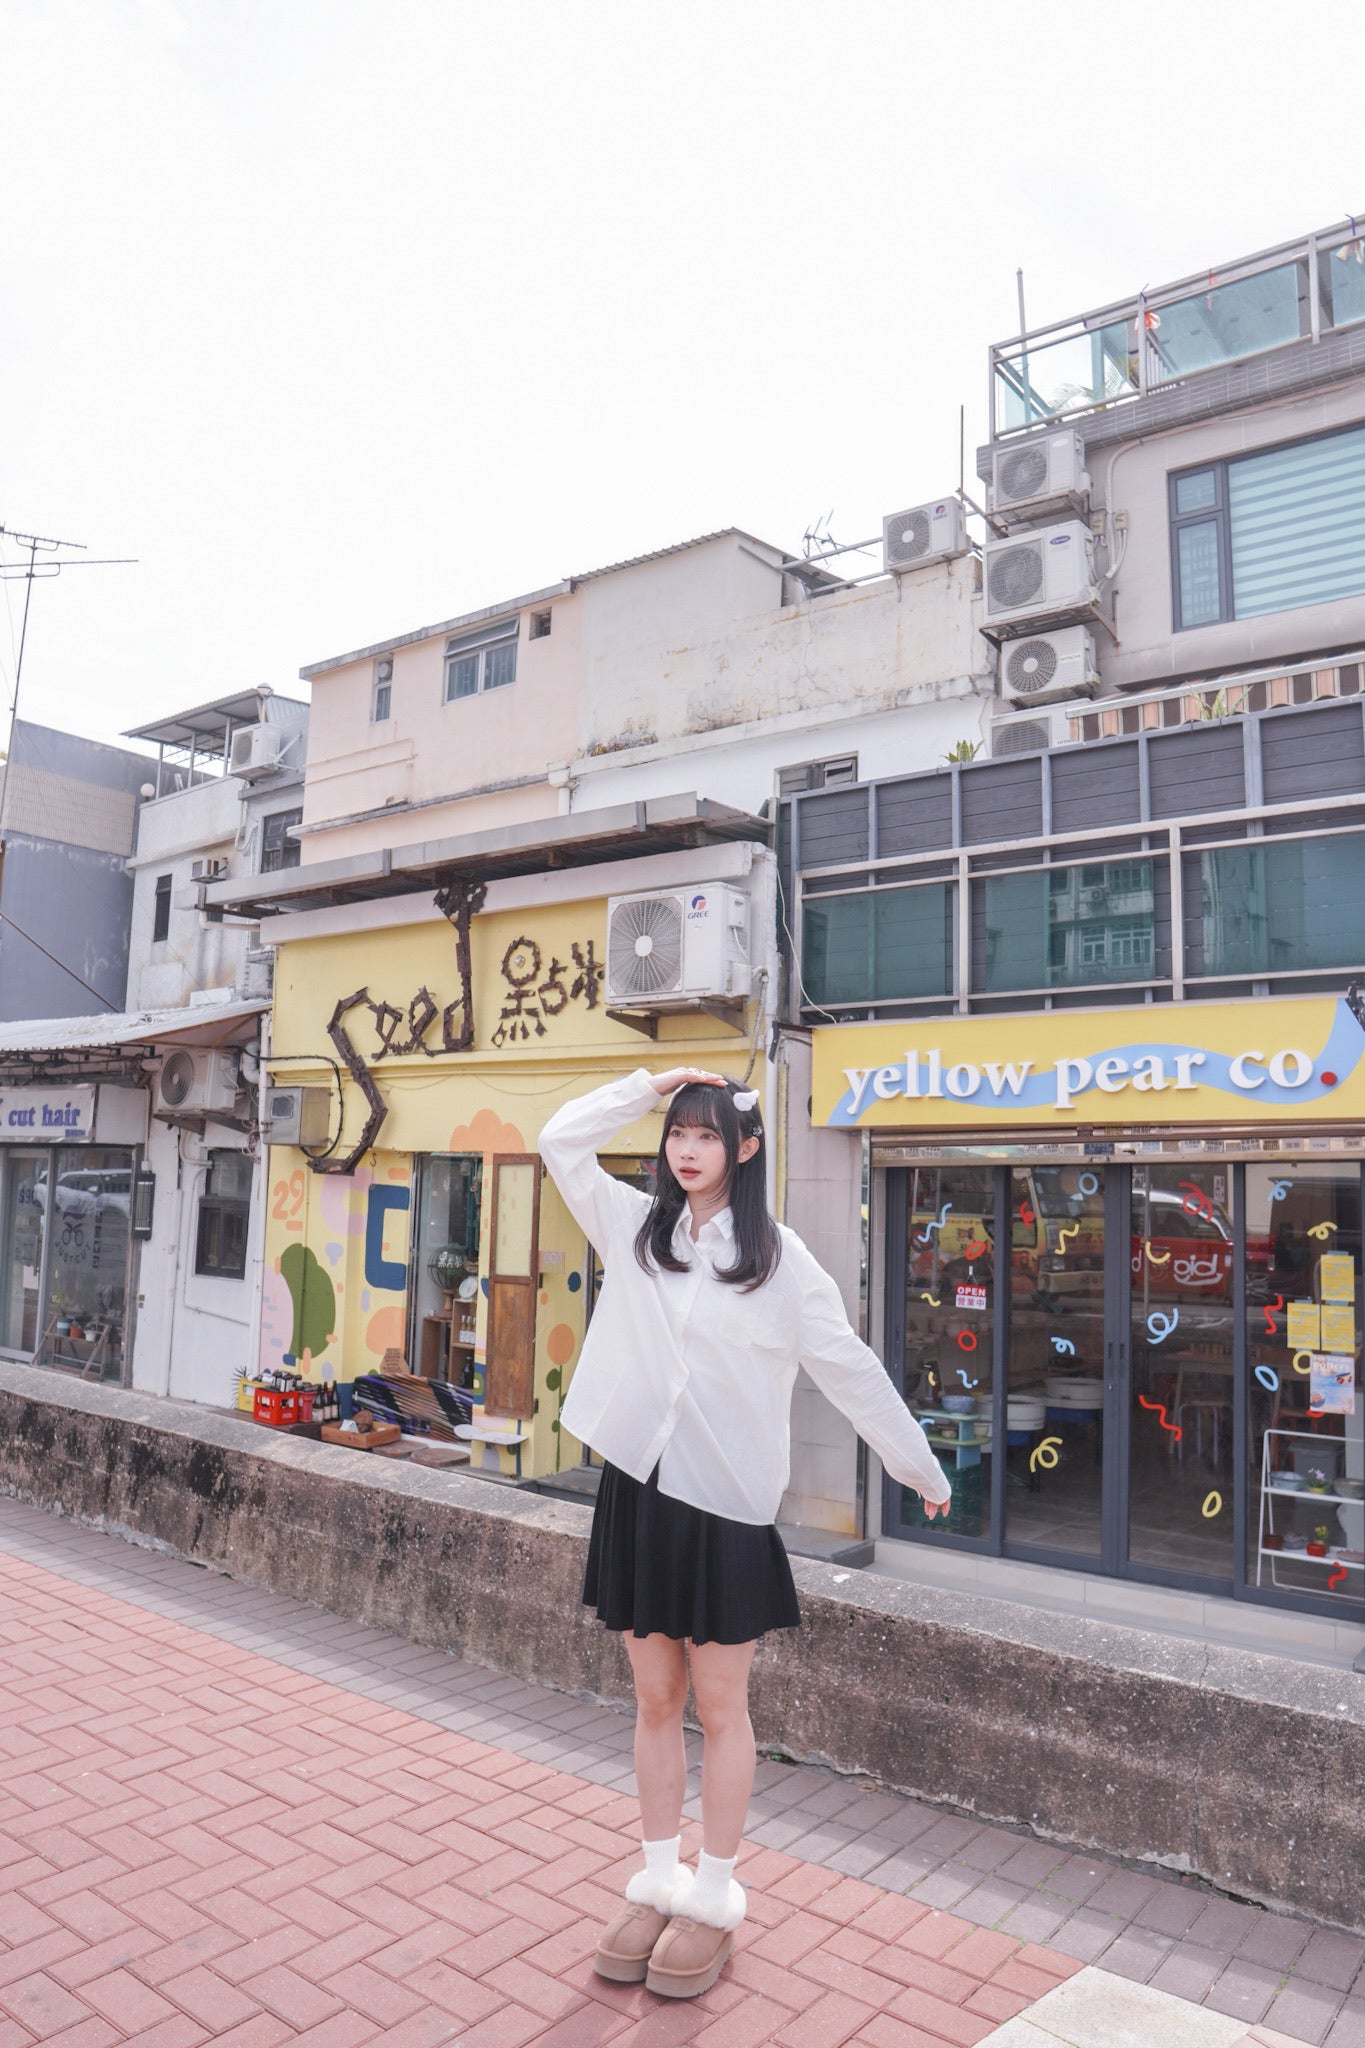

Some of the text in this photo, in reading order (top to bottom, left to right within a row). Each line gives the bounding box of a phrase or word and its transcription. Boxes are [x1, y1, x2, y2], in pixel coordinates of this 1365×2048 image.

[687, 910, 711, 920] GREE
[305, 879, 488, 1176] Seed
[842, 1048, 1337, 1115] yellow pear co.
[8, 1106, 36, 1126] cut
[41, 1102, 81, 1127] hair
[271, 1169, 305, 1220] 29
[957, 1286, 986, 1297] OPEN
